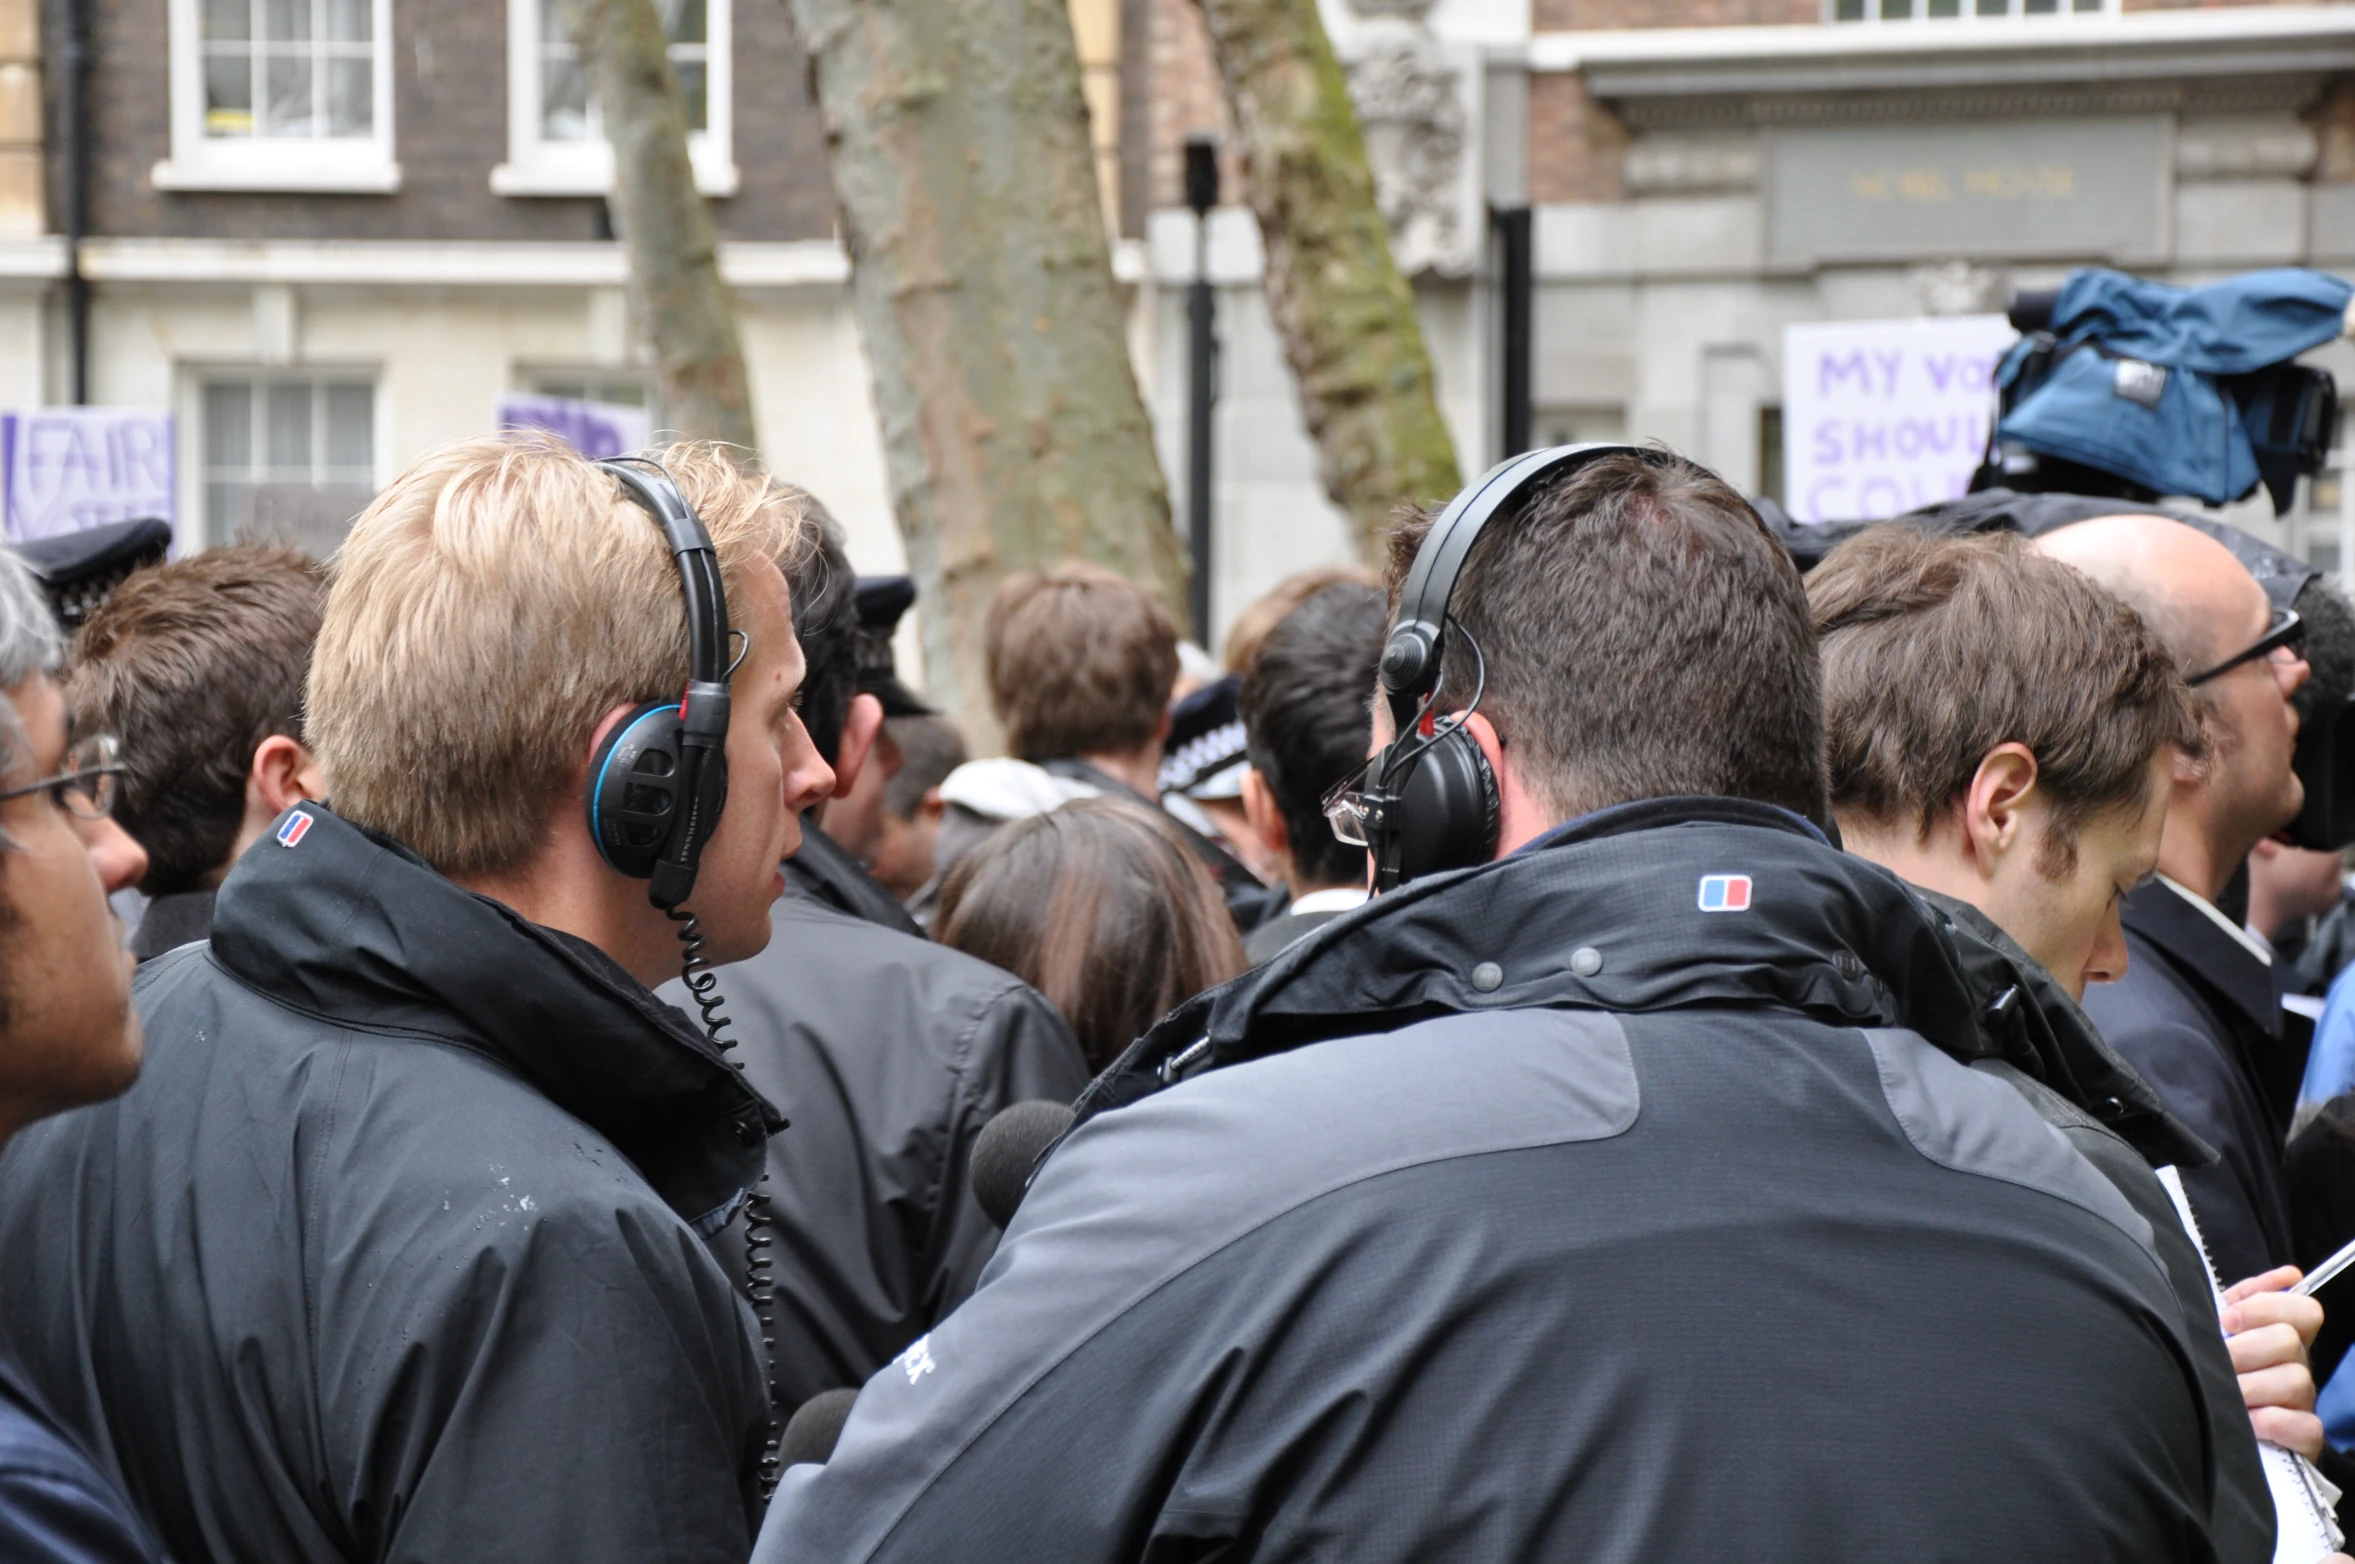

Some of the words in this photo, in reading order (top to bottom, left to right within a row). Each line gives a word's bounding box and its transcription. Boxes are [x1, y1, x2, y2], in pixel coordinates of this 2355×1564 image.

[1819, 349, 1902, 397] MY
[1924, 354, 1996, 392] VO
[27, 416, 165, 497] FAIR
